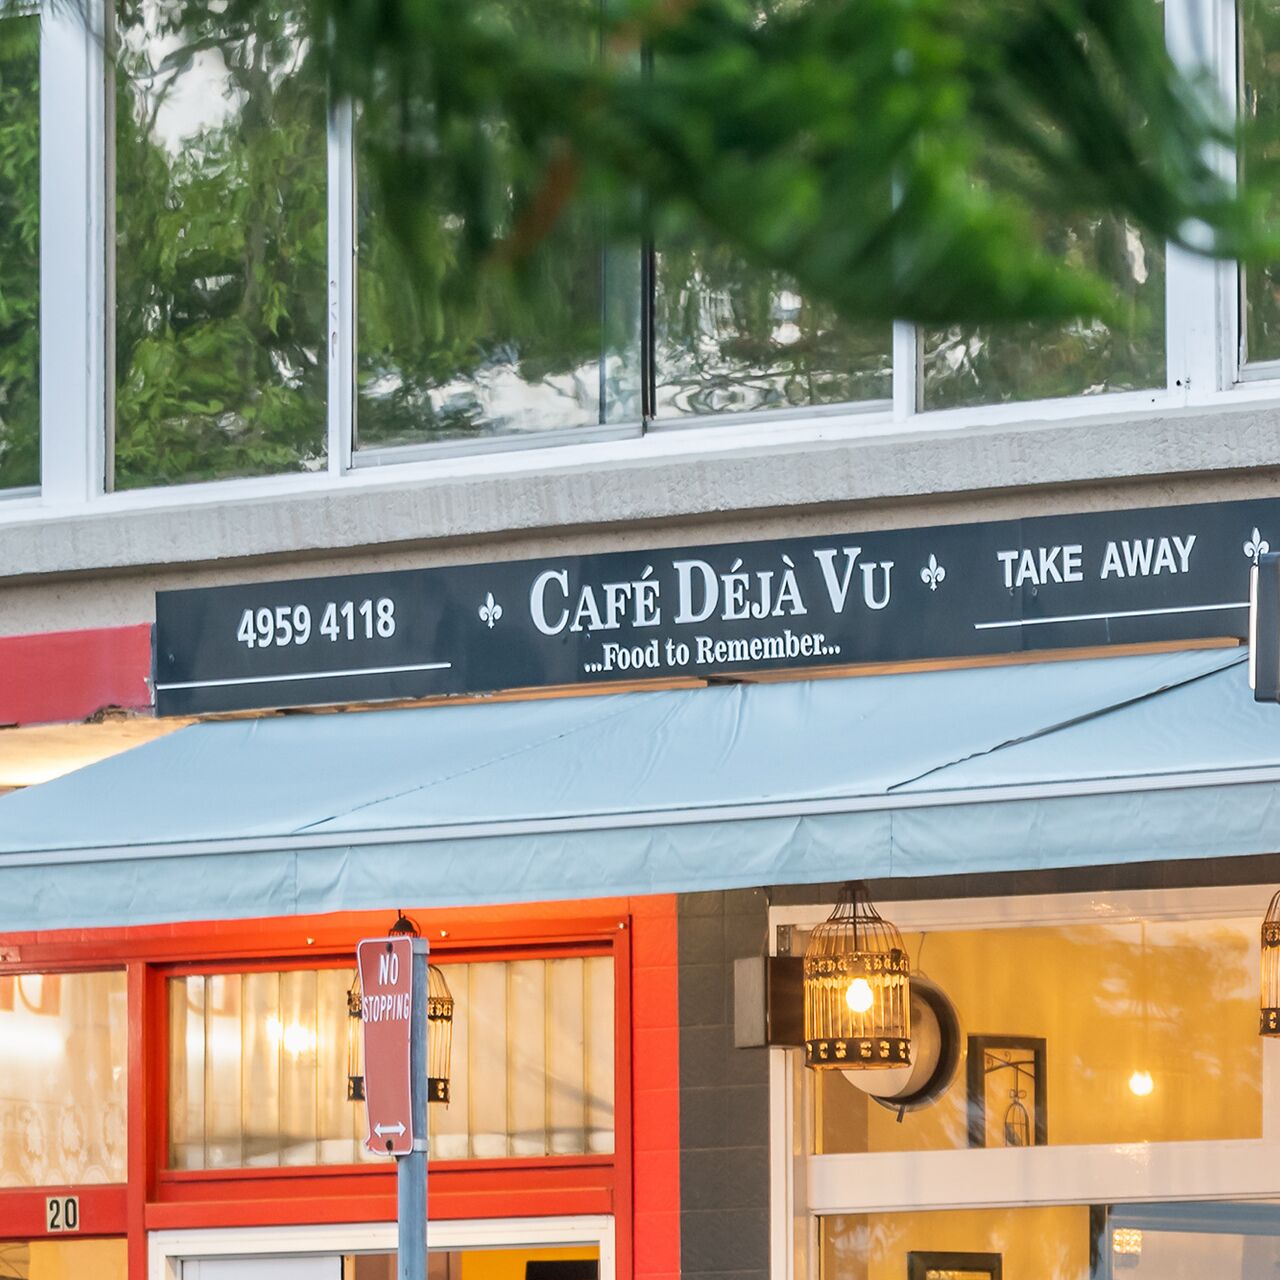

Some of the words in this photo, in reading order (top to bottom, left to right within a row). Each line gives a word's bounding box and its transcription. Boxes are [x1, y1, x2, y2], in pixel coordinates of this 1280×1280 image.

[997, 544, 1084, 590] TAKE
[1100, 535, 1197, 581] AWAY
[529, 565, 661, 636] CAFÉ
[674, 556, 807, 625] DÉJÀ
[814, 547, 895, 614] VU
[237, 605, 312, 650] 4959
[320, 598, 397, 644] 4118
[584, 641, 660, 675] ...Food
[665, 640, 689, 666] to
[695, 628, 842, 666] Remember...
[378, 953, 399, 986] NO
[362, 992, 411, 1024] STOPPING
[48, 1198, 79, 1230] 20
